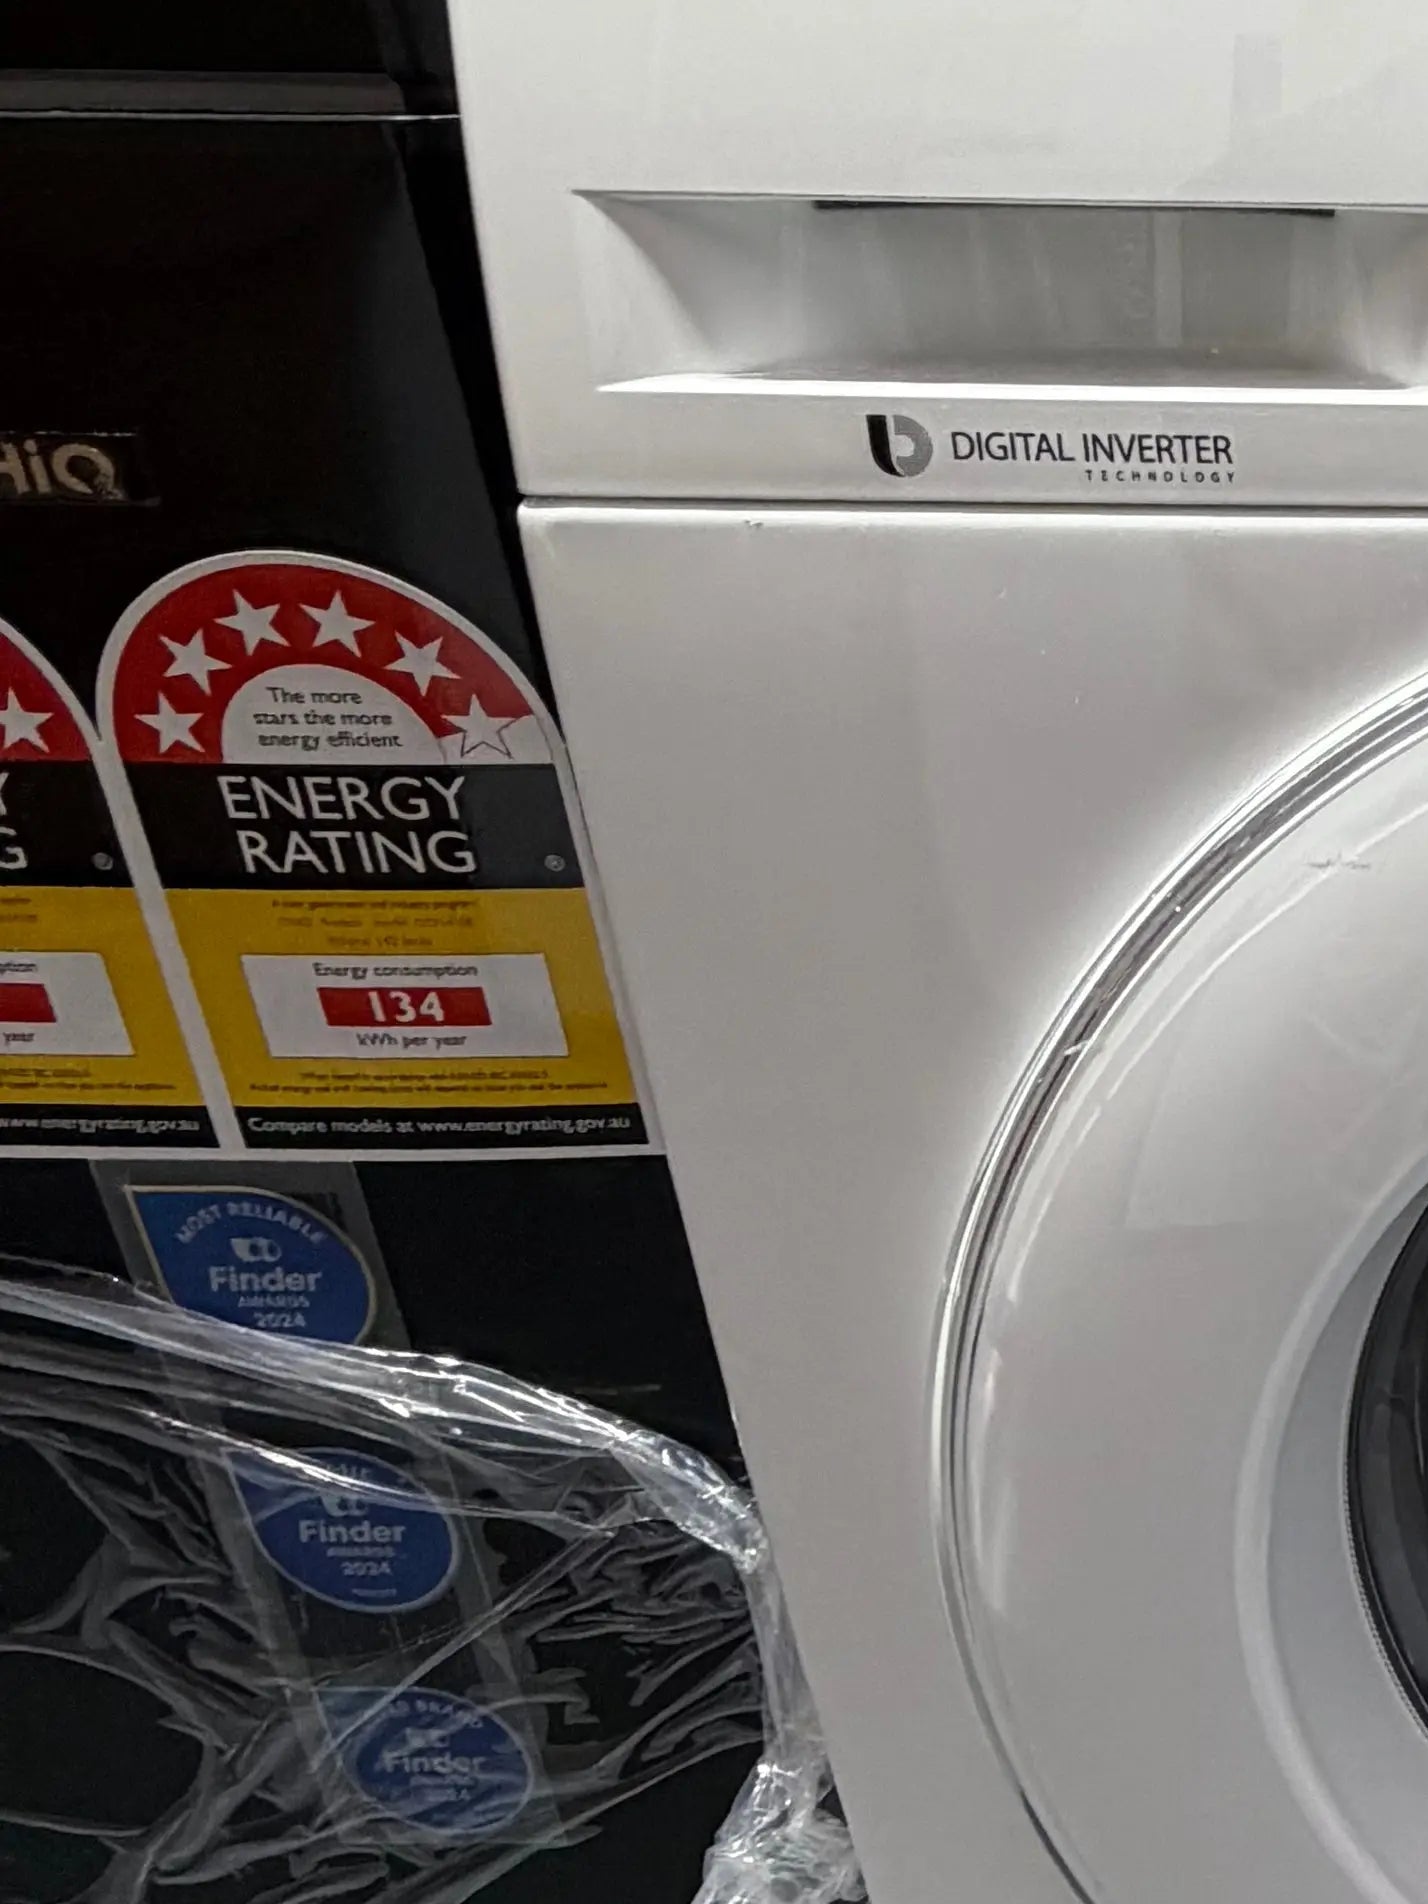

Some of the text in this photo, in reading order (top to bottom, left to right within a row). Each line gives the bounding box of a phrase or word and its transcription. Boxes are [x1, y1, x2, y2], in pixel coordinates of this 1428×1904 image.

[951, 431, 1234, 464] DIGITAL INVERTER
[1084, 469, 1236, 484] TECHNOLOGY
[265, 686, 363, 705] The more
[252, 708, 393, 726] stars the more
[257, 731, 403, 752] energy efficient
[217, 775, 466, 821] ENERGY
[236, 829, 478, 875] RATING
[313, 962, 479, 981] Energy consumption
[368, 990, 446, 1024] 134
[402, 1033, 430, 1049] per
[434, 1034, 468, 1050] year
[247, 1117, 328, 1136] Compare
[331, 1117, 393, 1134] models
[396, 1120, 416, 1134] at
[209, 1265, 323, 1293] Finder
[299, 1518, 406, 1544] Finder
